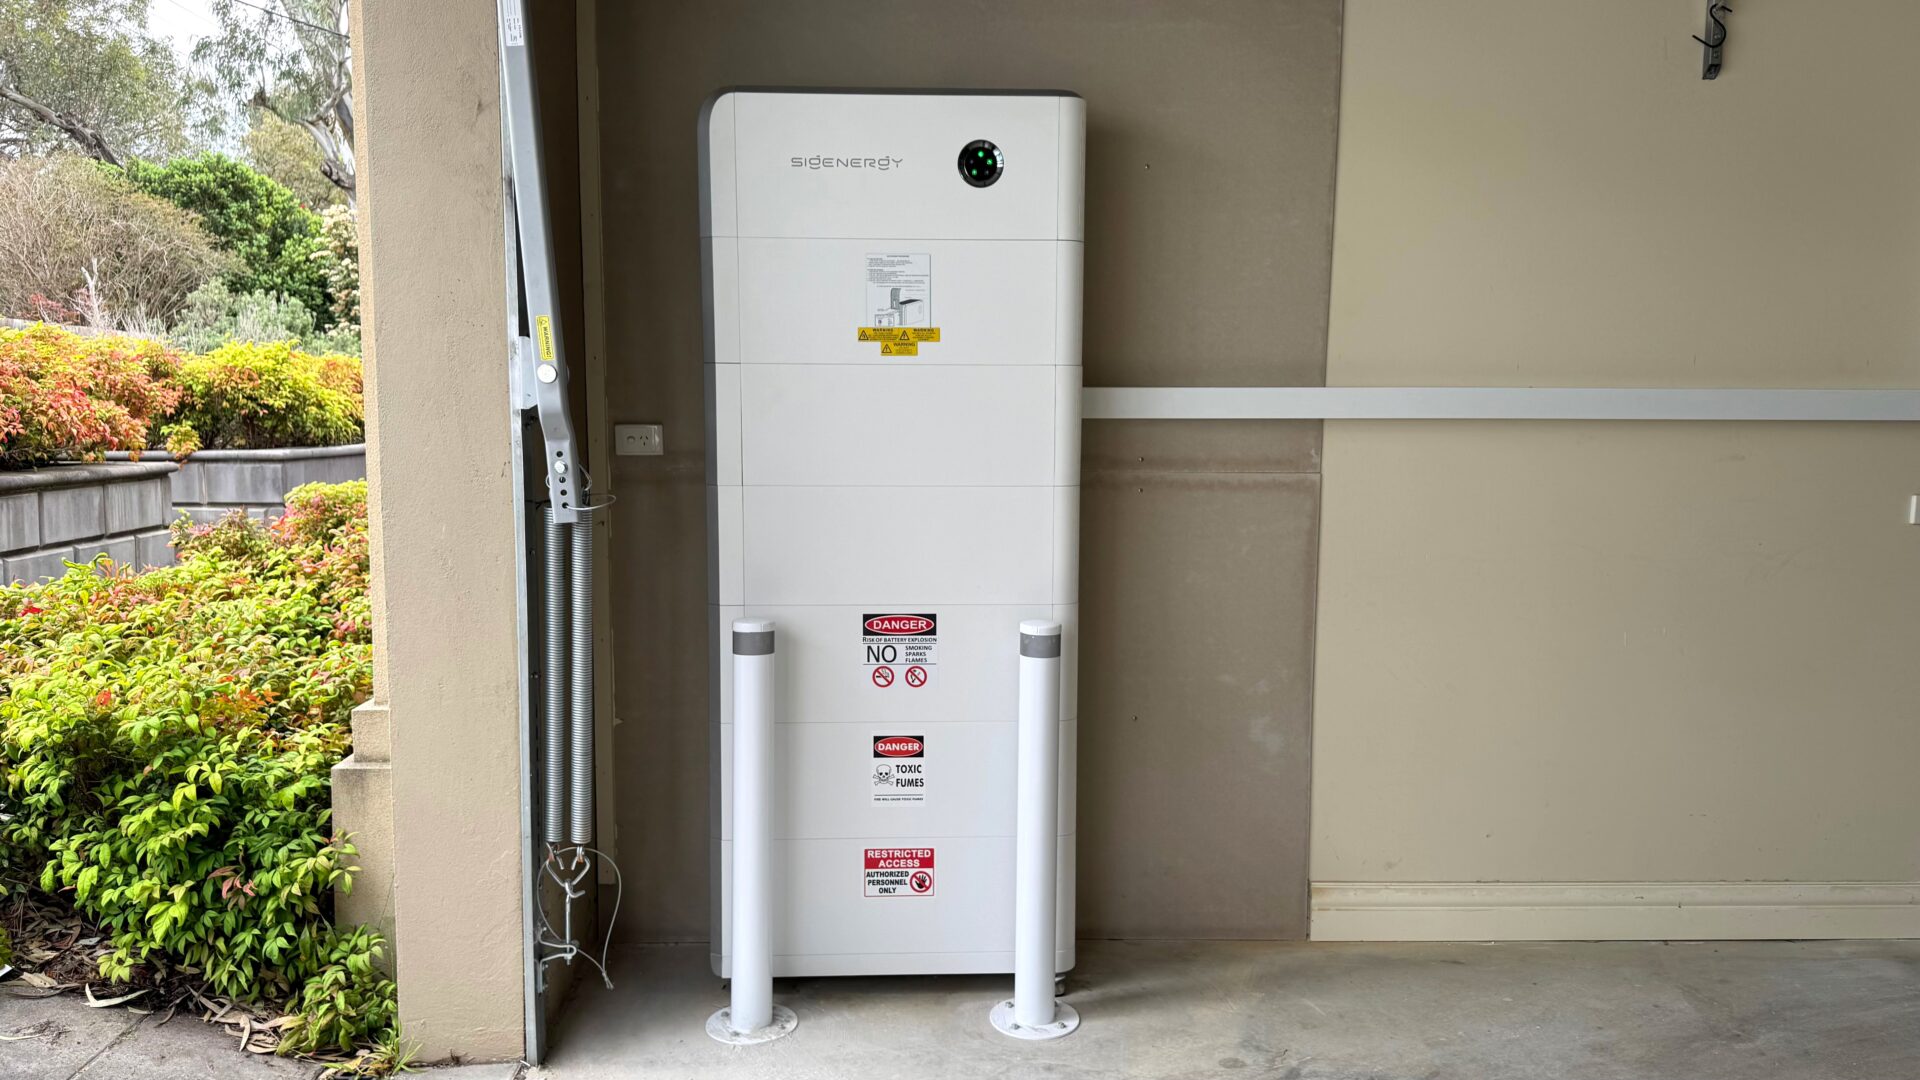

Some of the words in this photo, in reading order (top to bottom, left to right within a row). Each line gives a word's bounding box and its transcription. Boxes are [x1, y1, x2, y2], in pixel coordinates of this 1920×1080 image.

[873, 620, 927, 630] DANGER
[867, 645, 897, 663] NO
[896, 764, 922, 774] TOXIC
[896, 778, 924, 788] FUMES
[867, 849, 931, 858] RESTRICTED
[878, 859, 920, 868] ACCESS
